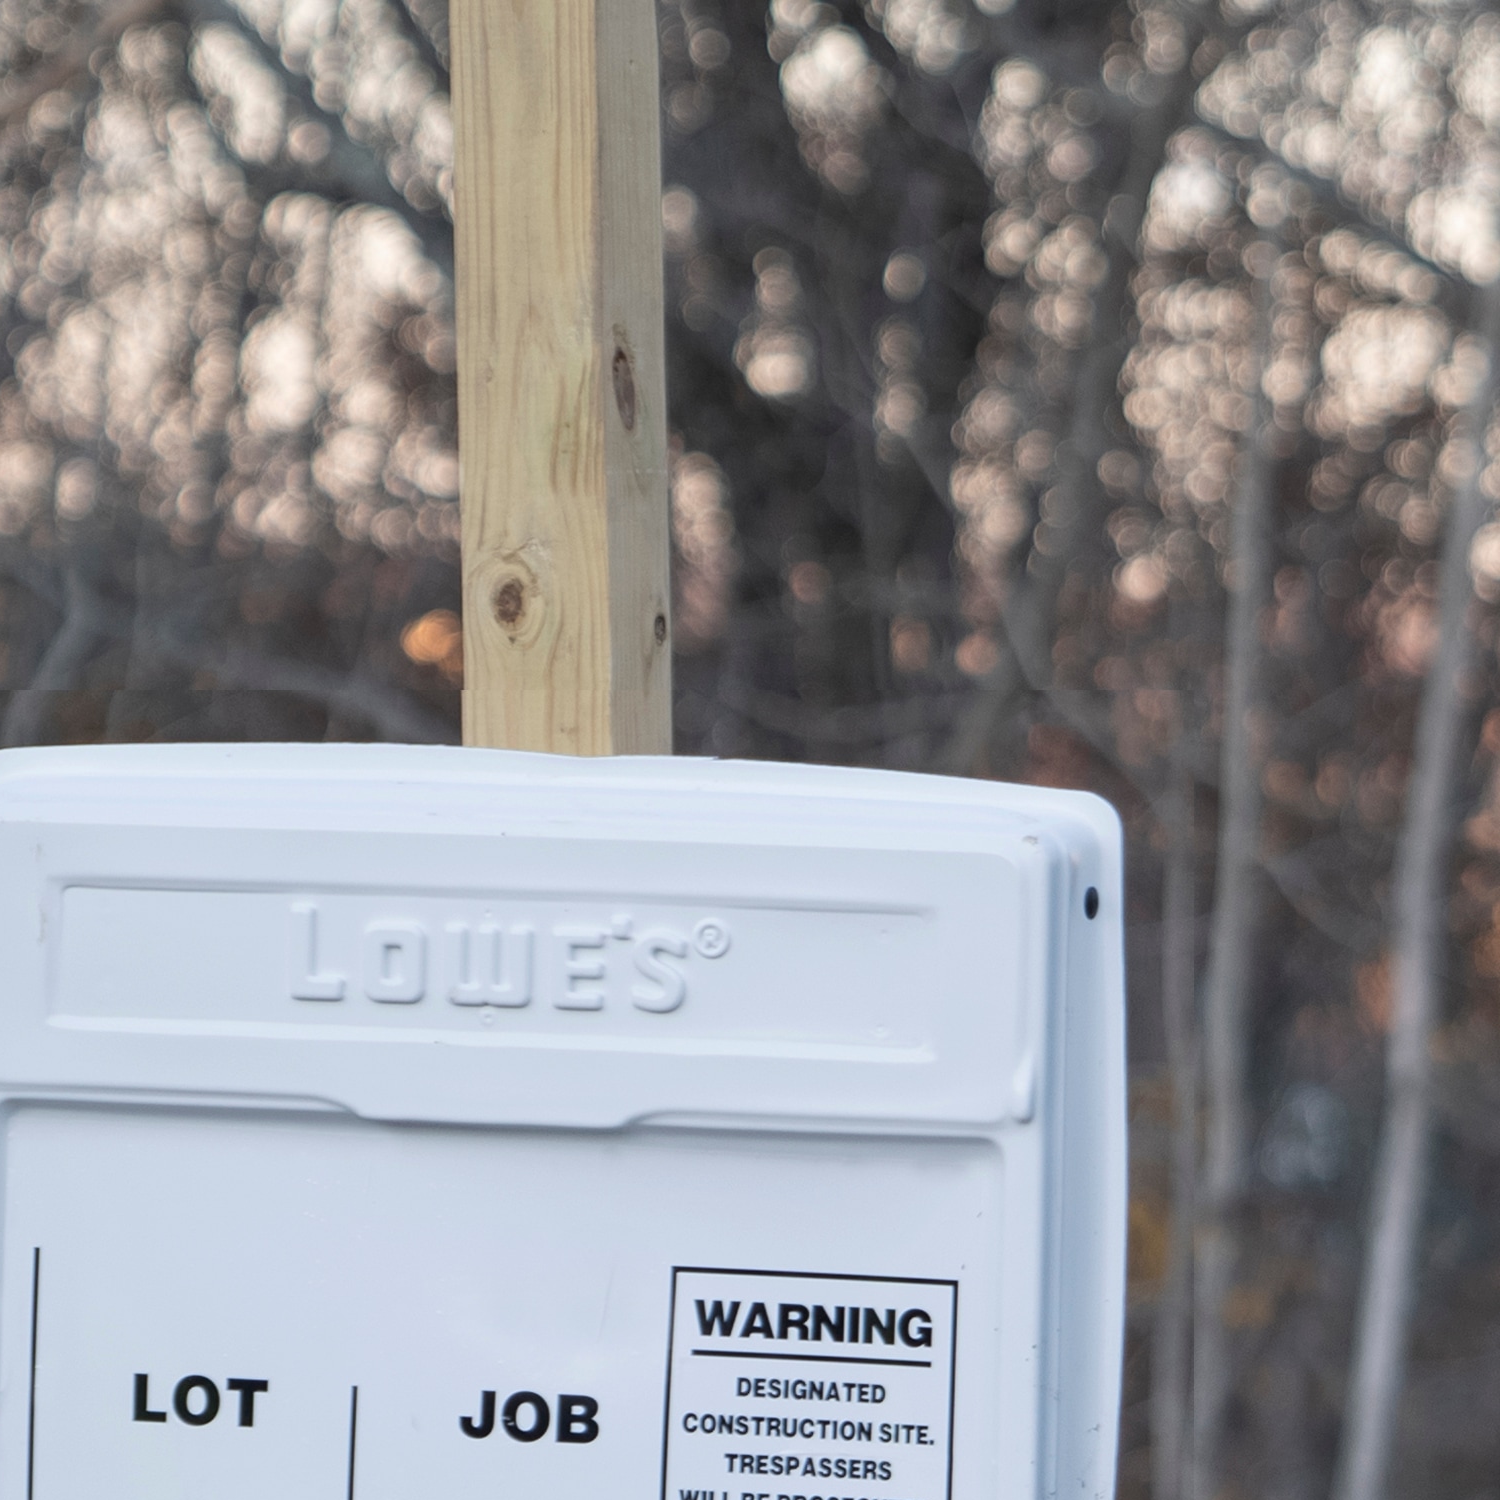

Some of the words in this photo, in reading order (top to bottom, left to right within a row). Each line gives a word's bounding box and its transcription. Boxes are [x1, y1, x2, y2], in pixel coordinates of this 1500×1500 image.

[694, 1299, 933, 1348] WARNING
[133, 1373, 269, 1428] LOT
[736, 1377, 886, 1404] DESIGNATED
[460, 1390, 599, 1444] JOB
[682, 1412, 873, 1442] CONSTRUCTION
[879, 1422, 935, 1446] SITE.
[724, 1453, 892, 1481] TRESPASSERS
